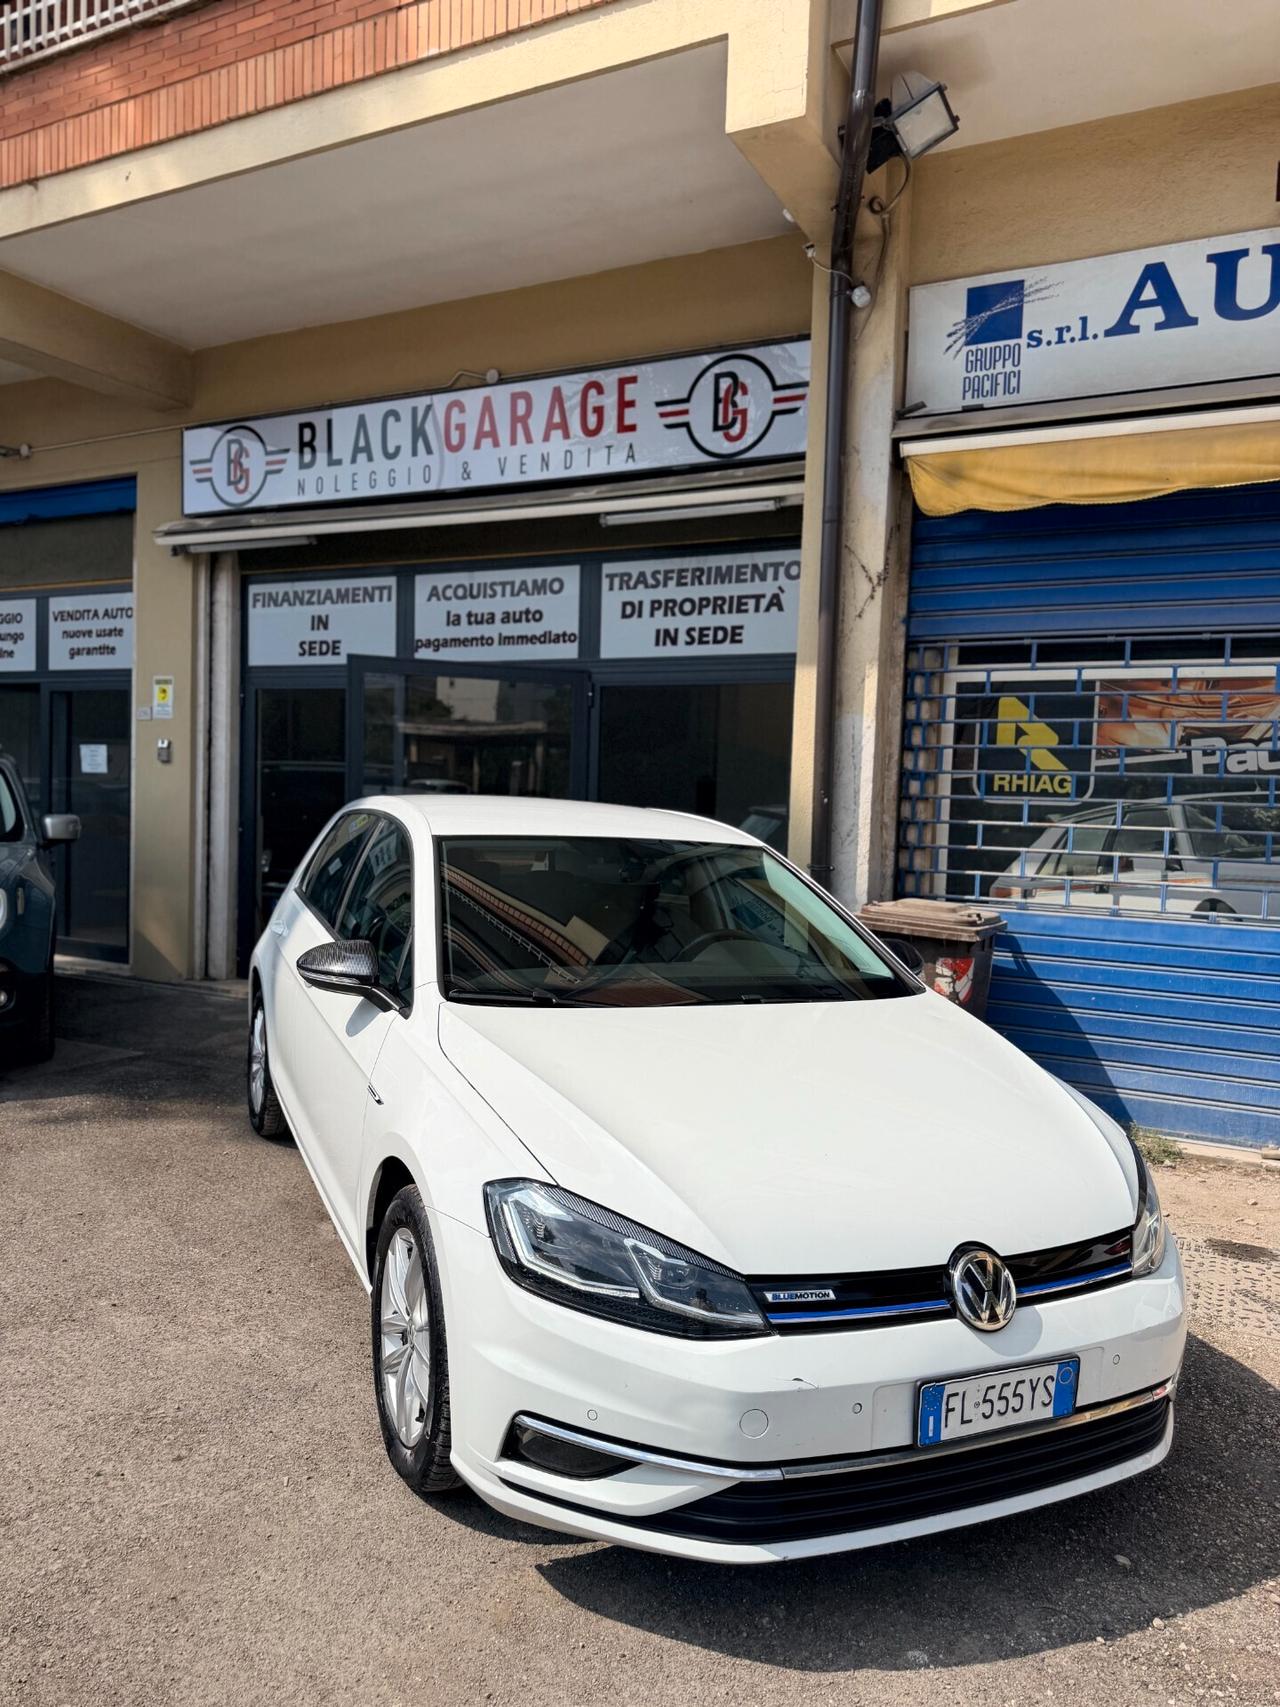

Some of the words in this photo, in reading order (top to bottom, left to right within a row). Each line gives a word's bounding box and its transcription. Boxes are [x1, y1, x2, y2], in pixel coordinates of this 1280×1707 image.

[1026, 316, 1099, 349] s.r.l.
[1103, 243, 1280, 338] AU
[964, 342, 1022, 374] GRUPPO
[962, 369, 1021, 400] PACIFICI
[297, 463, 432, 497] NOLEGGIO
[461, 461, 472, 481] &
[498, 443, 637, 477] VENDITA
[605, 560, 801, 592] TRASFERIMENTO
[252, 584, 393, 609] FINANZIAMENTI
[426, 576, 565, 602] ACQUISTIAMO
[52, 608, 99, 622] VENDITA
[102, 602, 133, 619] AUTO
[621, 600, 644, 619] DI
[650, 585, 785, 618] PROPRIETÀ
[311, 614, 330, 632] IN
[446, 610, 461, 627] la
[466, 609, 496, 626] tua
[501, 606, 544, 624] auto
[62, 628, 93, 640] nuove
[95, 625, 124, 638] usate
[415, 634, 494, 652] pagamento
[498, 629, 578, 646] immediato
[654, 628, 679, 647] IN
[684, 625, 745, 646] SEDE
[69, 643, 117, 660] garantite
[298, 639, 342, 657] SEDE
[993, 773, 1073, 794] RHIAG
[771, 1291, 831, 1301] BLUEMOTION
